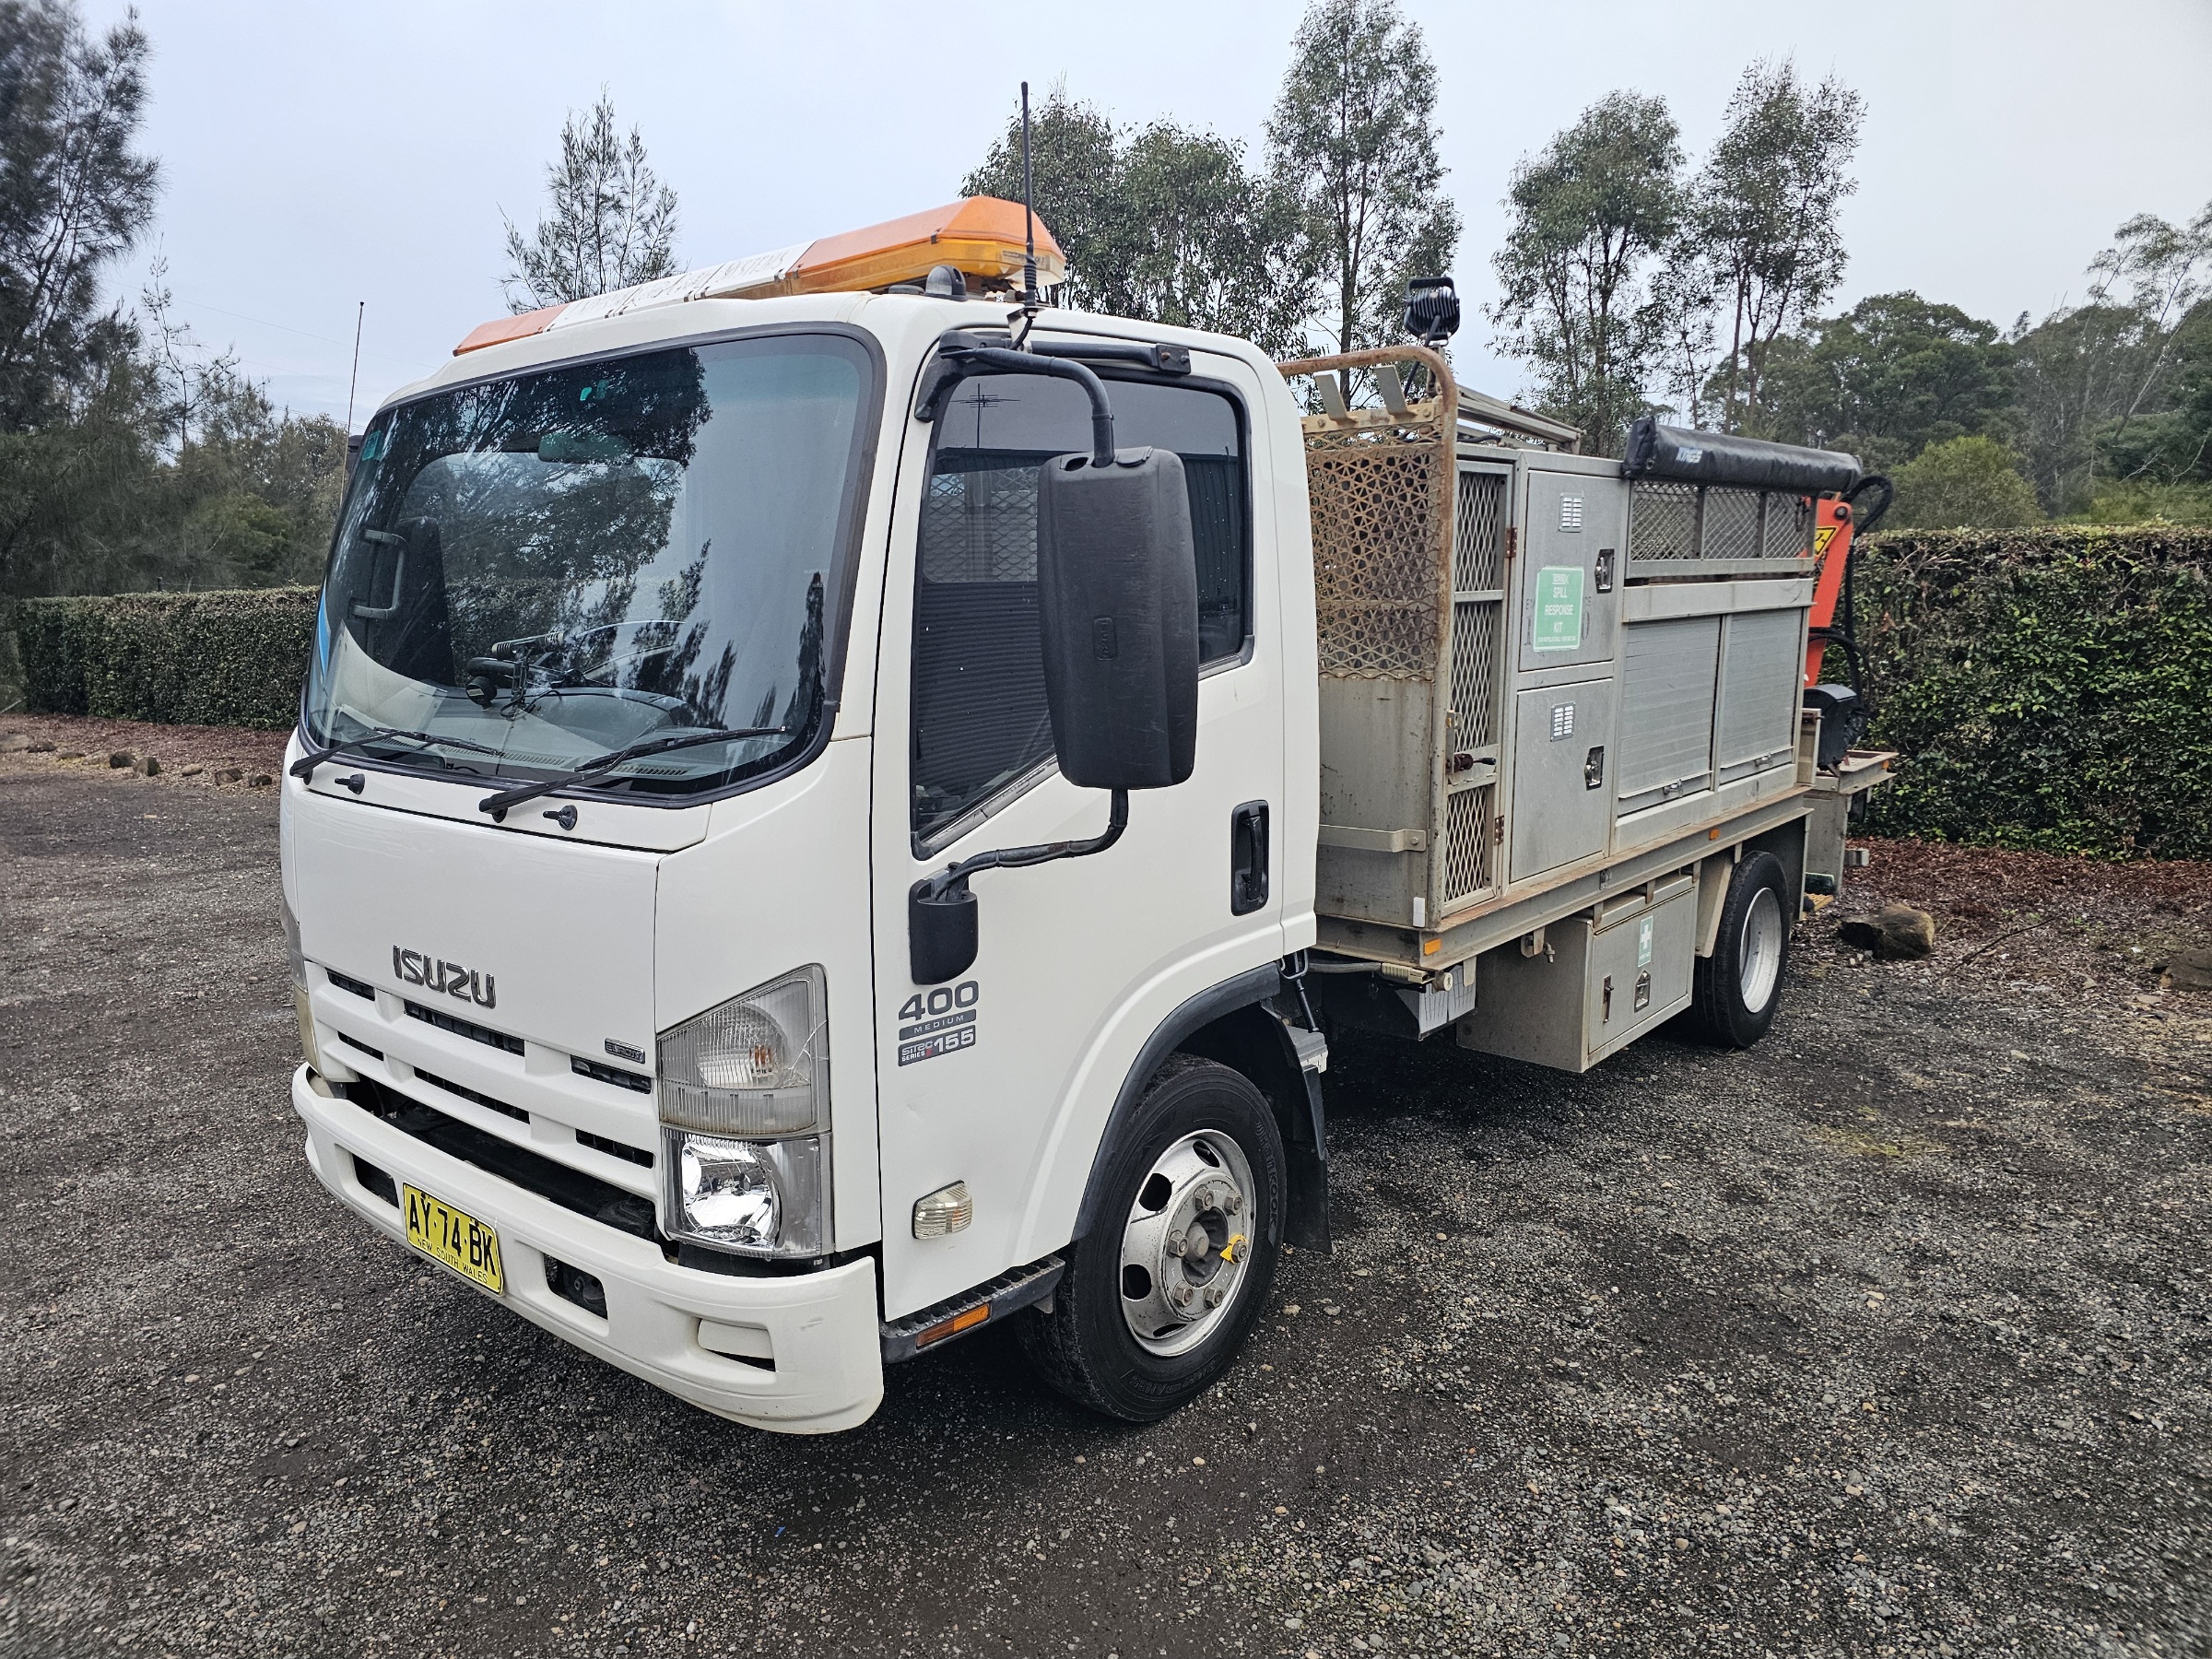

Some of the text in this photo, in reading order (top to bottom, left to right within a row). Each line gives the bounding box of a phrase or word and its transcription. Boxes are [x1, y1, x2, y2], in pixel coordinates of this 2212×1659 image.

[1553, 586, 1568, 598] SPILL
[1545, 605, 1573, 616] RESPONSE
[1553, 622, 1563, 633] KIT
[393, 945, 496, 1009] ISUZU
[898, 980, 979, 1020] 400
[913, 1015, 964, 1033] MEDIUM
[933, 1028, 974, 1053] 155
[901, 1050, 925, 1062] SERIES
[418, 1237, 488, 1284] NEW SOUTH WALES
